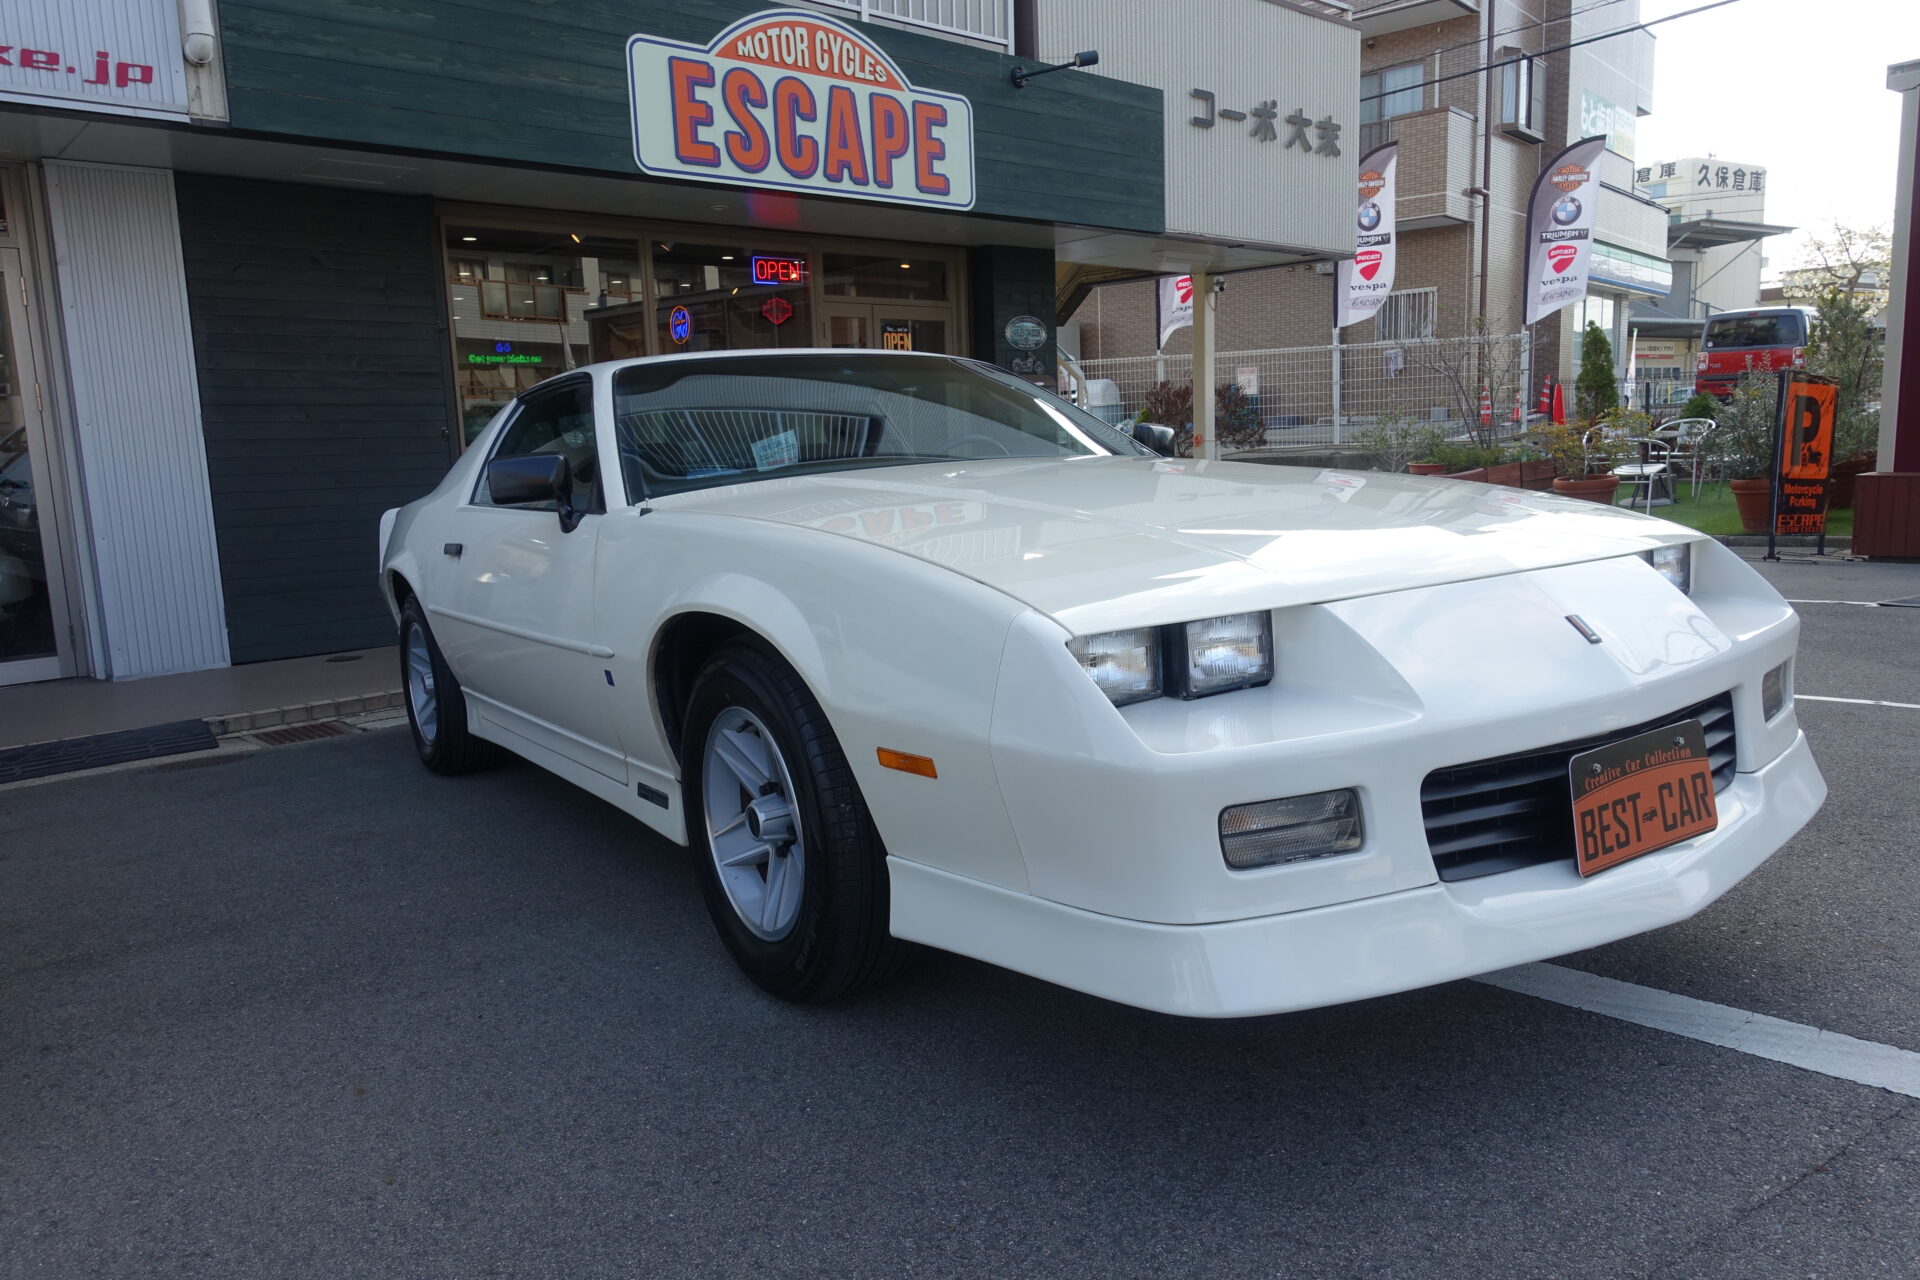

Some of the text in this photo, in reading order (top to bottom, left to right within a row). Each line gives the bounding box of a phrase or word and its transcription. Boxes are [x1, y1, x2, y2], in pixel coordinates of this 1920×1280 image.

[736, 26, 887, 82] MOTOR CYCLES
[668, 56, 950, 196] ESCAPE
[1697, 163, 1763, 193] 久保倉庫
[1357, 235, 1382, 244] IUMPH
[1541, 230, 1579, 240] TRIUMPH
[756, 260, 800, 281] OPEN
[1350, 282, 1387, 291] vespa
[1541, 276, 1577, 286] vespa
[883, 332, 912, 350] OPEN
[1784, 483, 1823, 496] Motorcycle
[1789, 496, 1817, 509] Parking
[1776, 514, 1824, 526] ESCAPE
[1584, 747, 1692, 791] Creative Car Collection
[1580, 771, 1713, 861] BEST CAR
